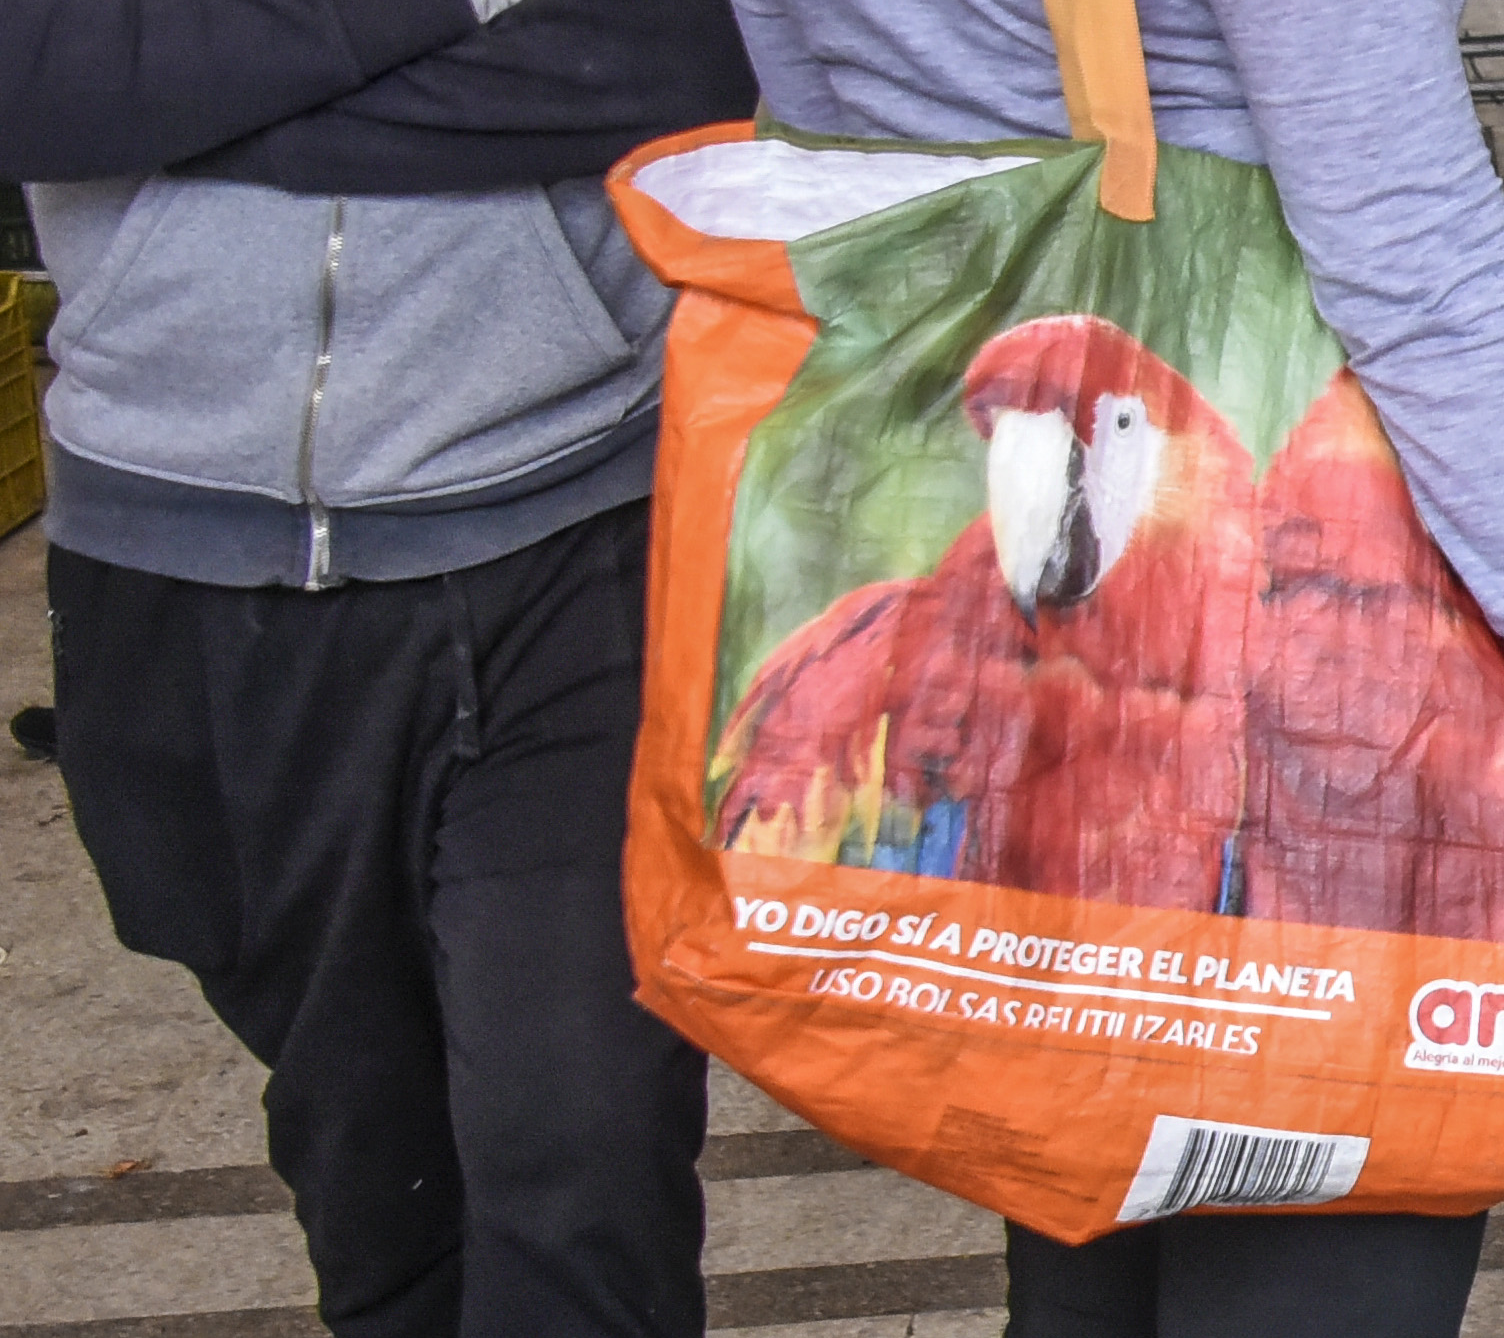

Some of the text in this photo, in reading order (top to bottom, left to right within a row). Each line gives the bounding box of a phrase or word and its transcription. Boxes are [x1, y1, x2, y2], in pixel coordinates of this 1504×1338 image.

[734, 896, 1356, 1002] YO DIGO SÍ A PROTEGER EL PLANETA
[809, 967, 884, 1001] USO
[884, 976, 1022, 1027] BOLSAS
[1462, 1055, 1475, 1066] al
